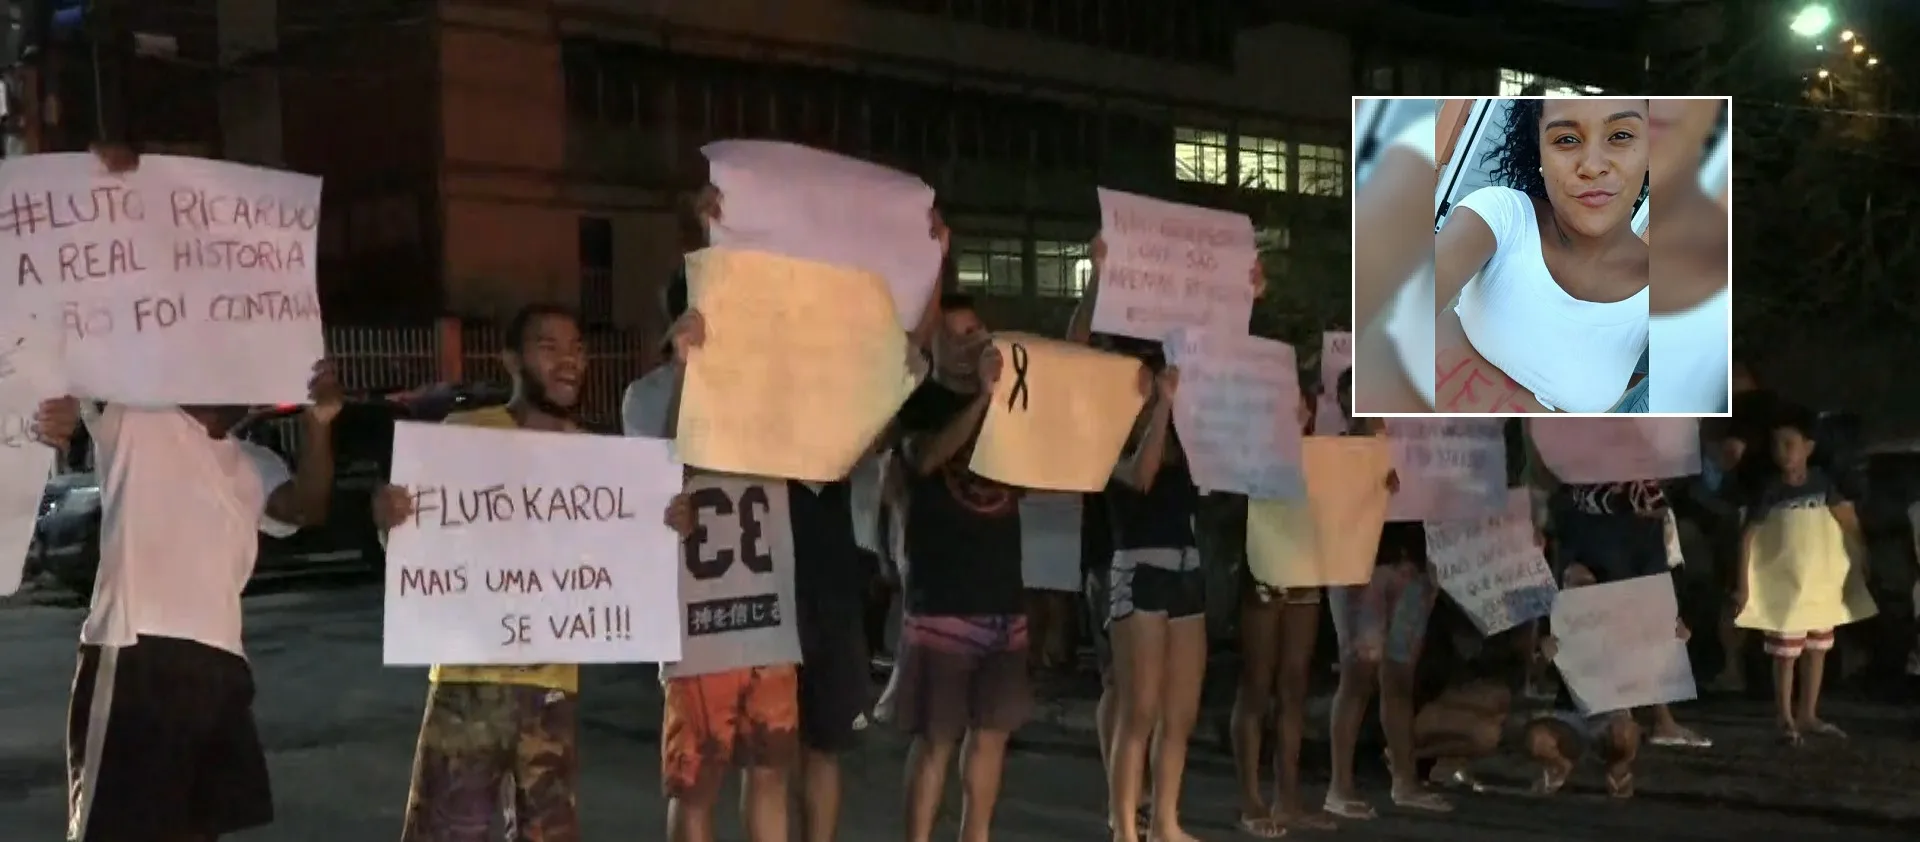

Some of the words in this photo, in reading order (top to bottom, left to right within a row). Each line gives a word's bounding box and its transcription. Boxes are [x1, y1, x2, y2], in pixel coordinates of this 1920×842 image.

[0, 187, 145, 235] #LUTO
[18, 253, 42, 285] A
[58, 239, 147, 282] REAL
[172, 238, 305, 271] HISTORIA
[134, 294, 187, 332] FOI
[522, 483, 635, 524] KAROL
[398, 564, 467, 598] MAIS
[485, 565, 542, 594] UMA
[551, 565, 613, 592] VIDA
[500, 615, 532, 646] SE
